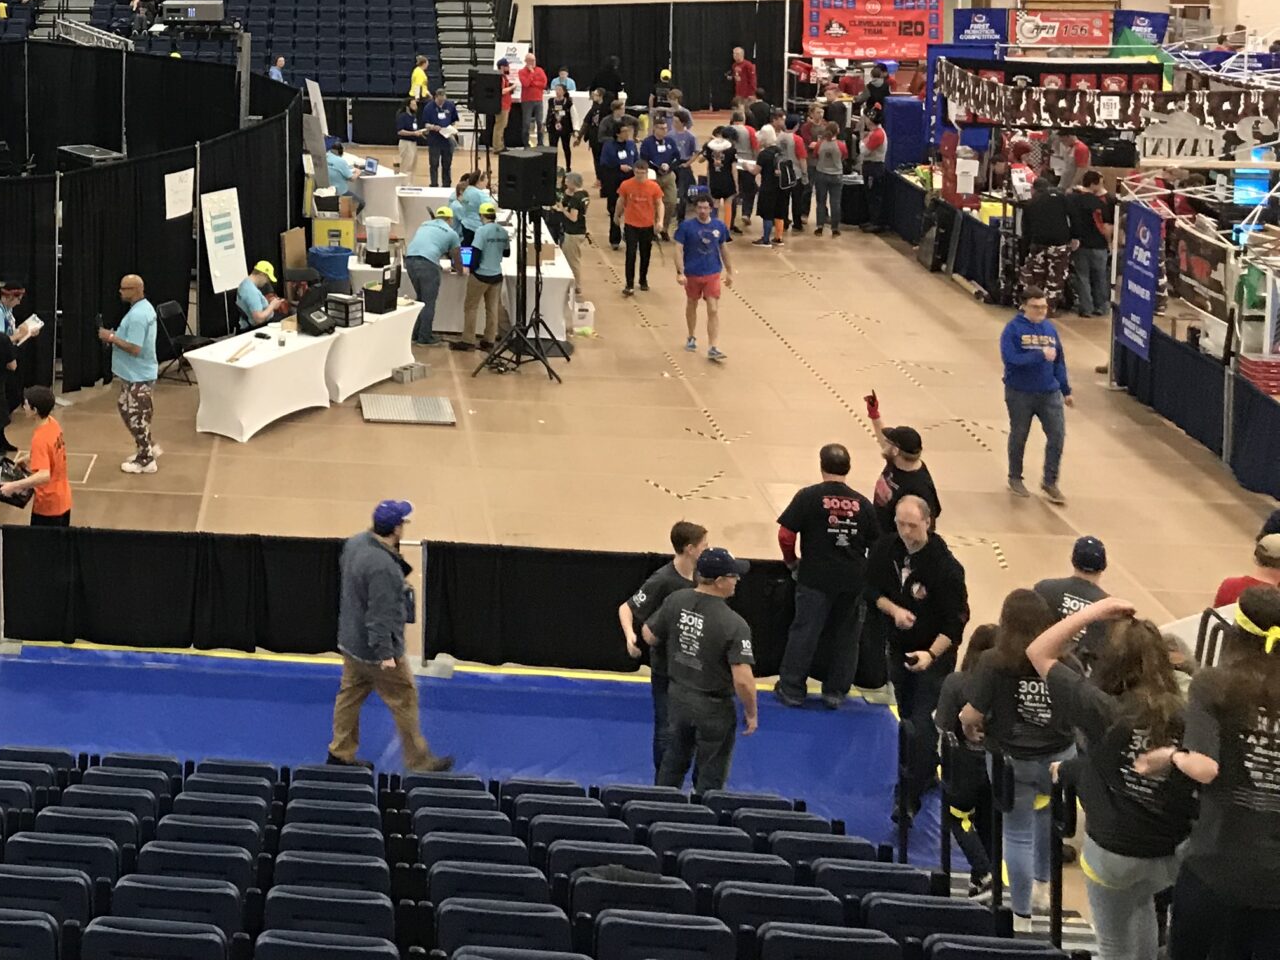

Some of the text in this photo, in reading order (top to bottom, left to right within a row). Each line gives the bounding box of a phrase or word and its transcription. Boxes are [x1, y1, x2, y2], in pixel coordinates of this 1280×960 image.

[898, 21, 924, 36] 120
[680, 612, 704, 630] 3015
[741, 639, 752, 649] 10
